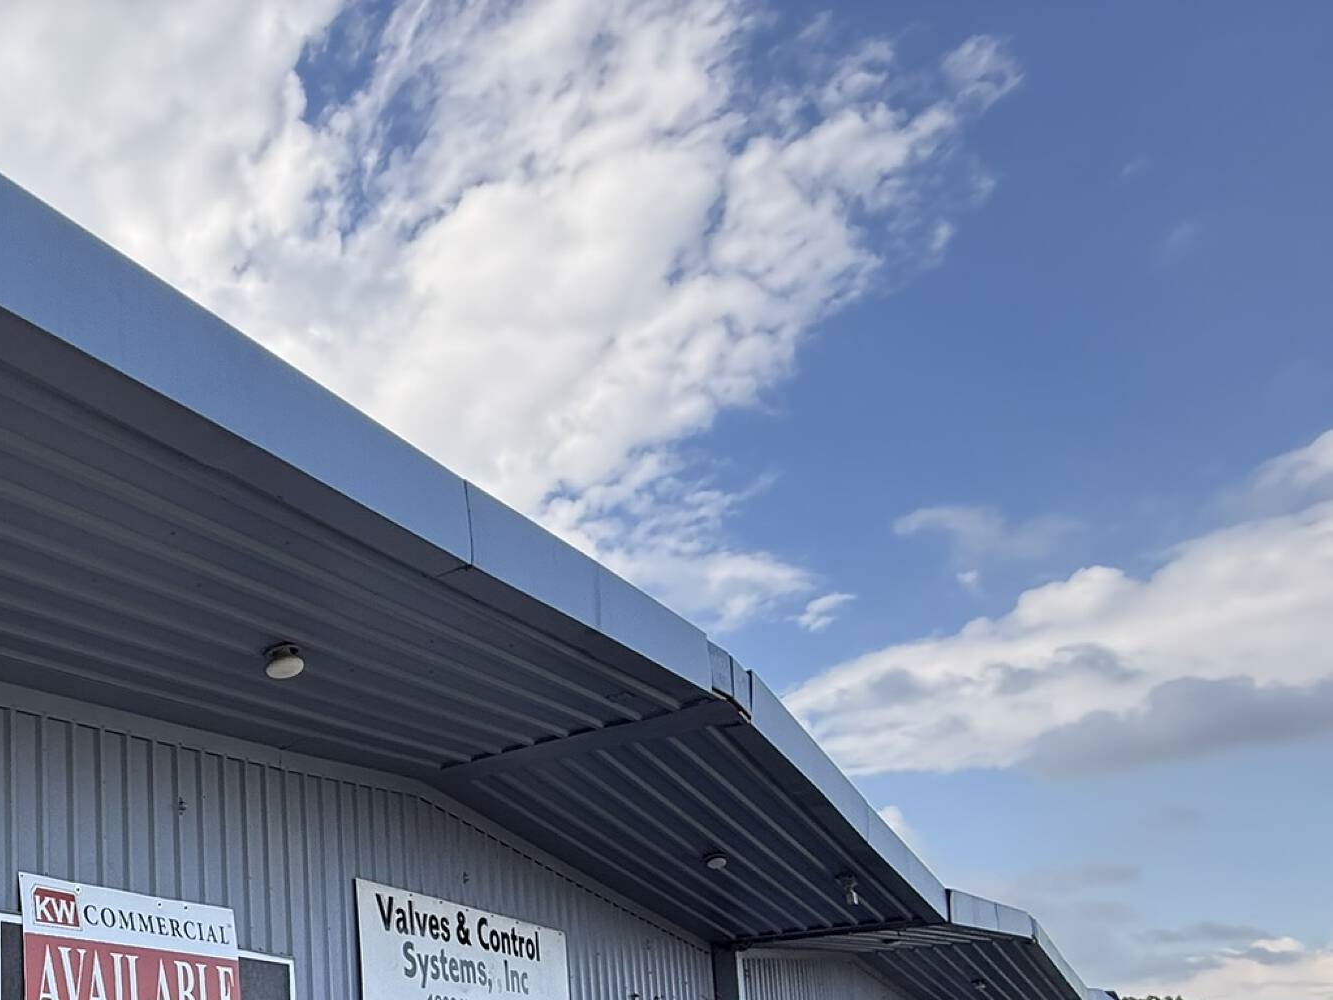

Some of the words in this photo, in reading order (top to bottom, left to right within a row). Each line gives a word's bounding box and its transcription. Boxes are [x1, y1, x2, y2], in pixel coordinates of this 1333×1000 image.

[33, 894, 76, 926] KW
[83, 904, 230, 945] COMMERCIAL
[375, 893, 451, 942] Valves
[457, 911, 472, 947] &
[477, 917, 541, 962] Control
[403, 940, 493, 994] Systems,
[504, 960, 529, 995] Inc
